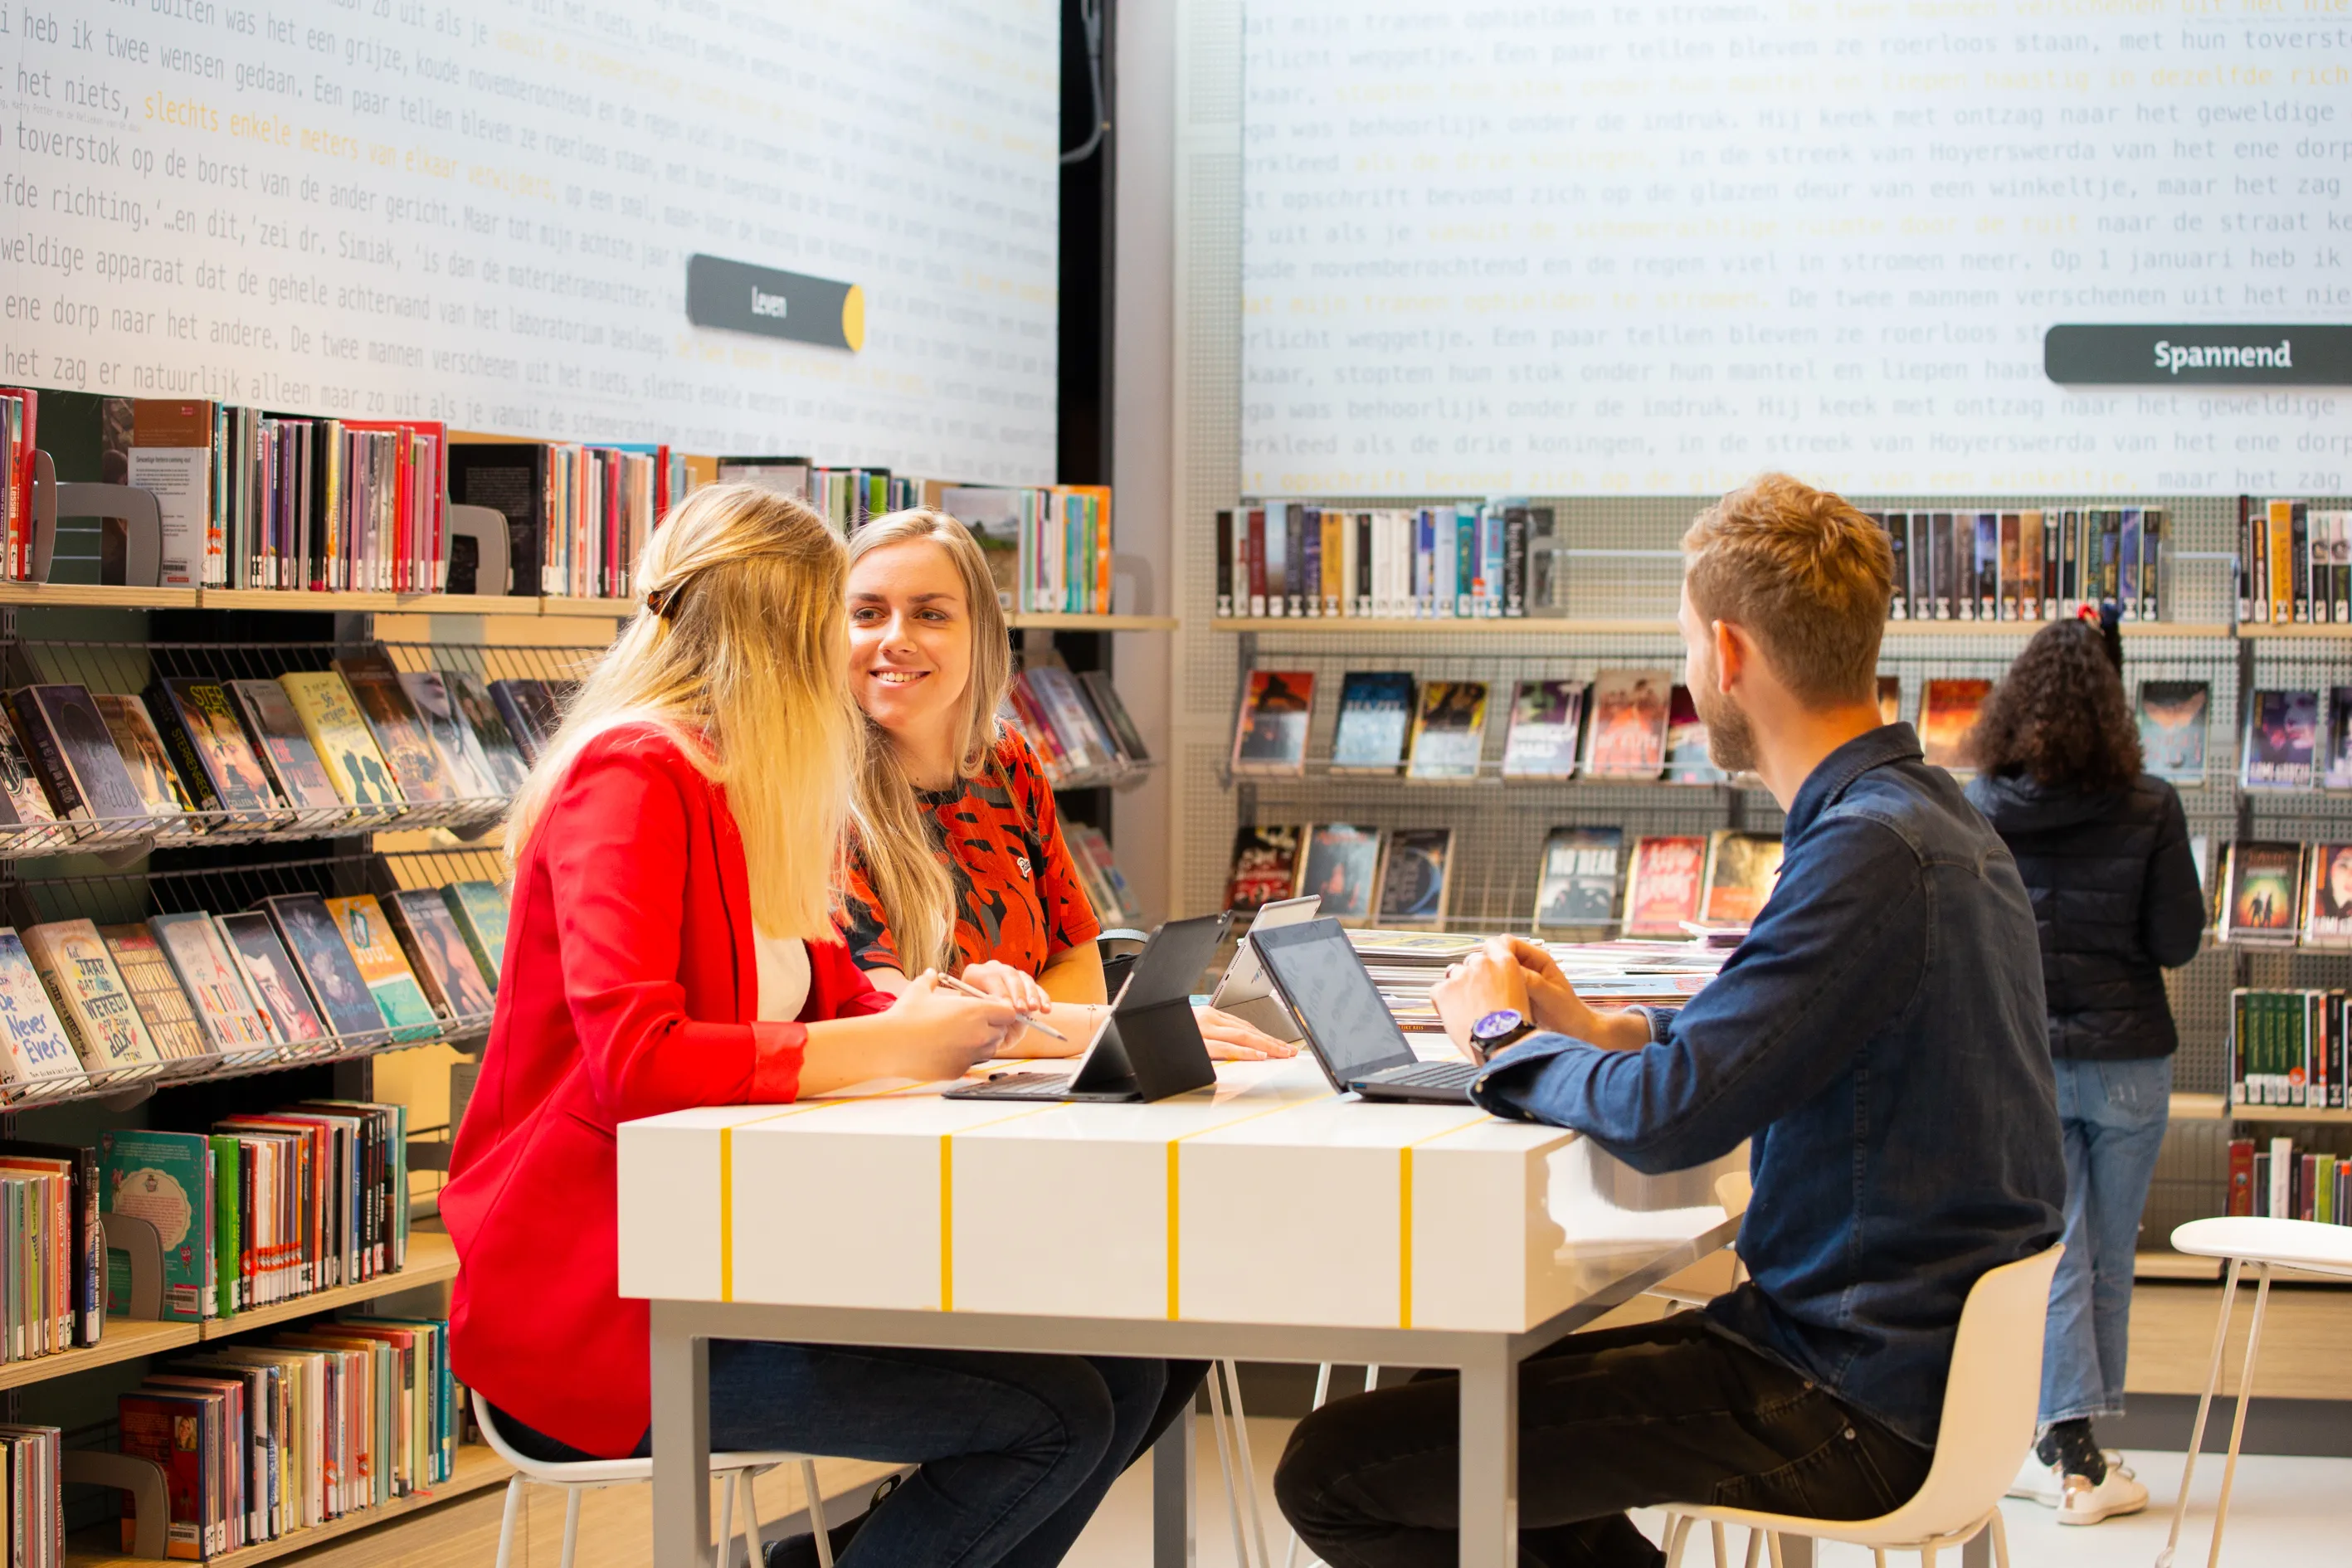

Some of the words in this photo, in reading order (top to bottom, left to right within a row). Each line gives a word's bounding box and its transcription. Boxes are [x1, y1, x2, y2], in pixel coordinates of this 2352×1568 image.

[226, 9, 256, 36] was
[267, 11, 295, 46] het
[307, 28, 335, 53] een
[345, 37, 408, 76] grijze,
[416, 49, 460, 85] koude
[2120, 31, 2163, 51] met
[2182, 29, 2226, 51] hun
[23, 7, 58, 44] heb
[71, 19, 92, 51] ik
[105, 28, 149, 64] twee
[160, 46, 223, 78] wensen
[236, 61, 303, 97] gedaan.
[314, 74, 342, 105] Een
[353, 90, 390, 114] paar
[399, 96, 452, 129] tellen
[461, 109, 512, 144] bleven
[520, 127, 538, 151] ze
[2152, 64, 2272, 87] dezelfde
[17, 62, 51, 98] het
[65, 75, 129, 119] niets,
[144, 90, 218, 132] slechts
[230, 112, 290, 146] enkele
[300, 128, 358, 160] meters
[369, 144, 396, 166] van
[405, 147, 457, 178] elkaar
[2136, 103, 2179, 124] het
[2198, 100, 2335, 127] geweldige
[2174, 139, 2215, 159] het
[2234, 142, 2279, 159] ene
[16, 120, 119, 165] toverstok
[132, 148, 153, 178] op
[165, 148, 186, 179] de
[197, 153, 248, 190] borst
[261, 173, 290, 196] van
[300, 174, 319, 203] de
[329, 183, 377, 212] ander
[386, 195, 456, 228] gericht.
[464, 206, 499, 235] Maar
[508, 216, 531, 241] tot
[2158, 178, 2218, 196] maar
[2235, 174, 2277, 195] het
[2298, 178, 2340, 200] zag
[2174, 212, 2203, 232] de
[2221, 211, 2309, 232] straat
[299, 225, 325, 255] dr.
[338, 230, 402, 271] Simiak,
[449, 251, 475, 278] dan
[482, 257, 501, 285] de
[2130, 246, 2233, 274] januari
[2251, 246, 2296, 268] heb
[2315, 247, 2341, 268] ik
[95, 251, 183, 285] apparaat
[196, 260, 226, 291] dat
[237, 266, 258, 296] de
[268, 273, 328, 306] gehele
[337, 283, 430, 320] achterwand
[440, 303, 465, 324] van
[474, 304, 498, 330] het
[752, 285, 786, 319] Leven
[2184, 285, 2224, 305] uit
[2245, 284, 2287, 305] het
[5, 295, 41, 321] ene
[53, 295, 99, 335] dorp
[111, 309, 155, 334] naar
[168, 308, 197, 340] het
[209, 318, 279, 351] andere.
[290, 324, 310, 354] De
[321, 331, 359, 361] twee
[368, 341, 422, 368] mannen
[432, 350, 518, 382] verschenen
[526, 362, 550, 385] uit
[558, 362, 582, 387] het
[2154, 339, 2292, 374] Spannend
[5, 343, 39, 377] het
[53, 357, 86, 389] zag
[100, 362, 121, 385] er
[133, 363, 240, 405] natuurlijk
[251, 372, 310, 408] alleen
[320, 386, 358, 409] maar
[366, 391, 385, 413] zo
[395, 393, 420, 416] uit
[430, 392, 456, 421] als
[465, 402, 483, 430] je
[2235, 435, 2281, 451] ene
[2235, 468, 2278, 488] het
[2298, 471, 2340, 493] zag
[76, 958, 109, 976] JAAR
[81, 992, 129, 1020] WERELD
[6, 1013, 48, 1040] Never
[212, 1014, 265, 1045] ANDERS
[22, 1032, 68, 1064] Evers
